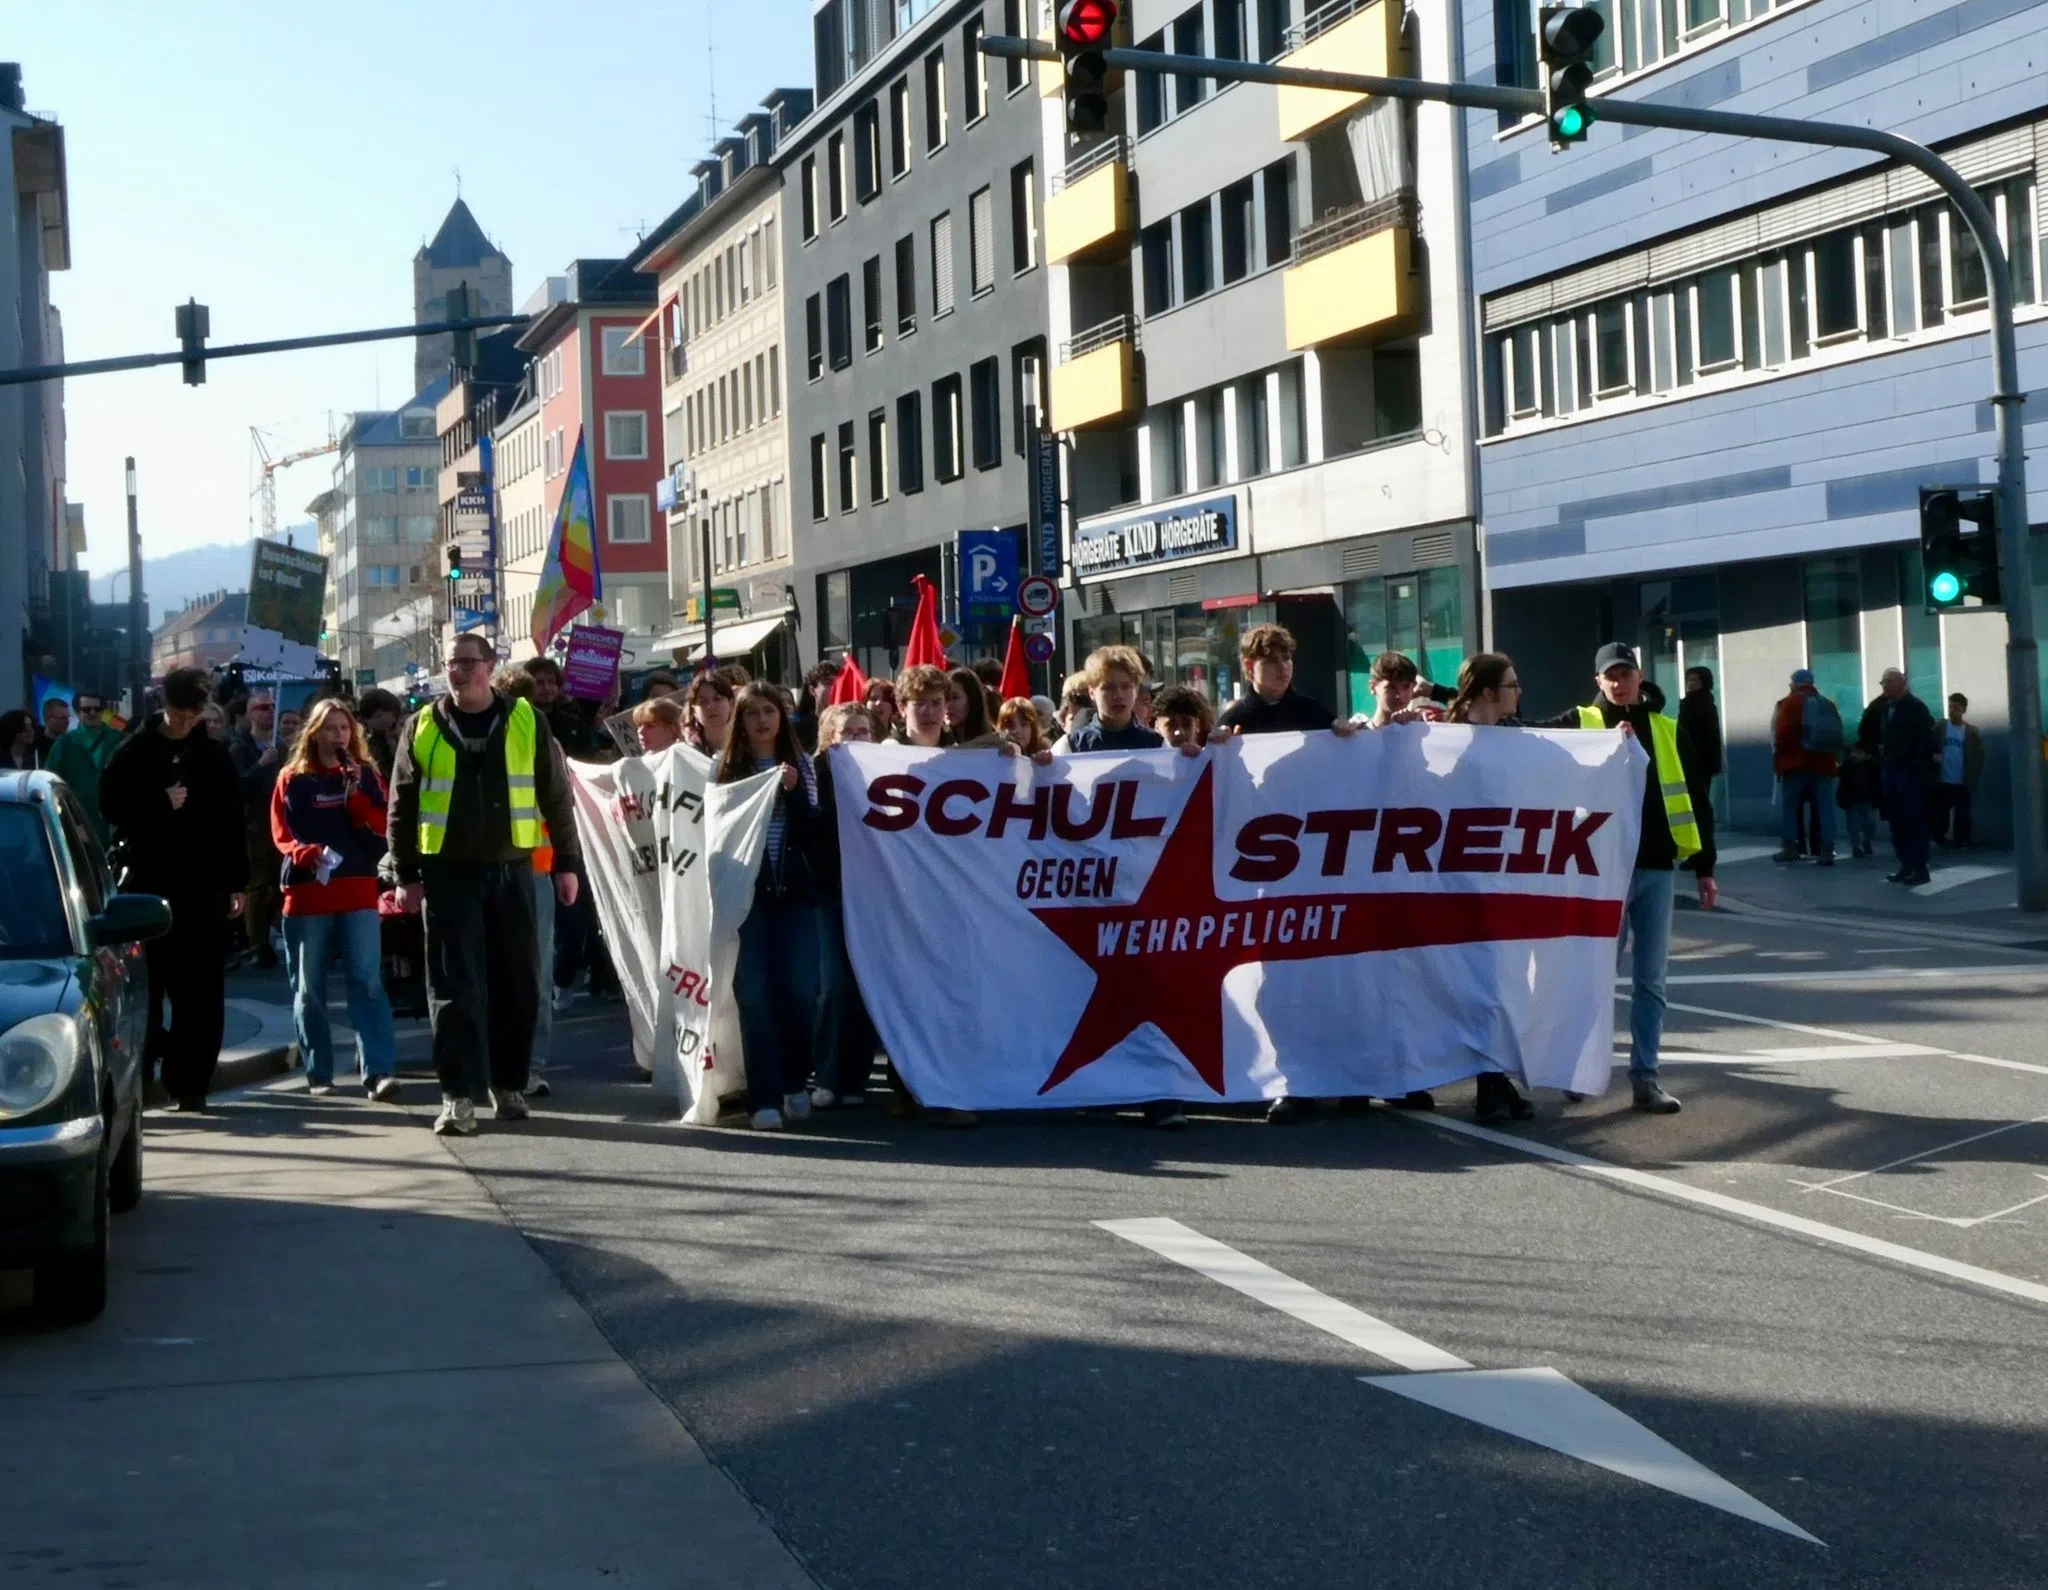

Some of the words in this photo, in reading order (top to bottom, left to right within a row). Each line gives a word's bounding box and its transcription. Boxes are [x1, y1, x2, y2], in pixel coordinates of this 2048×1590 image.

[460, 496, 486, 505] KKH
[1043, 522, 1057, 571] KIND
[1124, 521, 1157, 557] KIND
[1160, 509, 1218, 549] HÖRGERÄTE
[972, 554, 997, 593] P
[862, 774, 1167, 840] SCHUL
[1229, 807, 1613, 882] STREIK
[1016, 856, 1118, 899] GEGEN
[1097, 904, 1347, 957] WEHRPFLICHT
